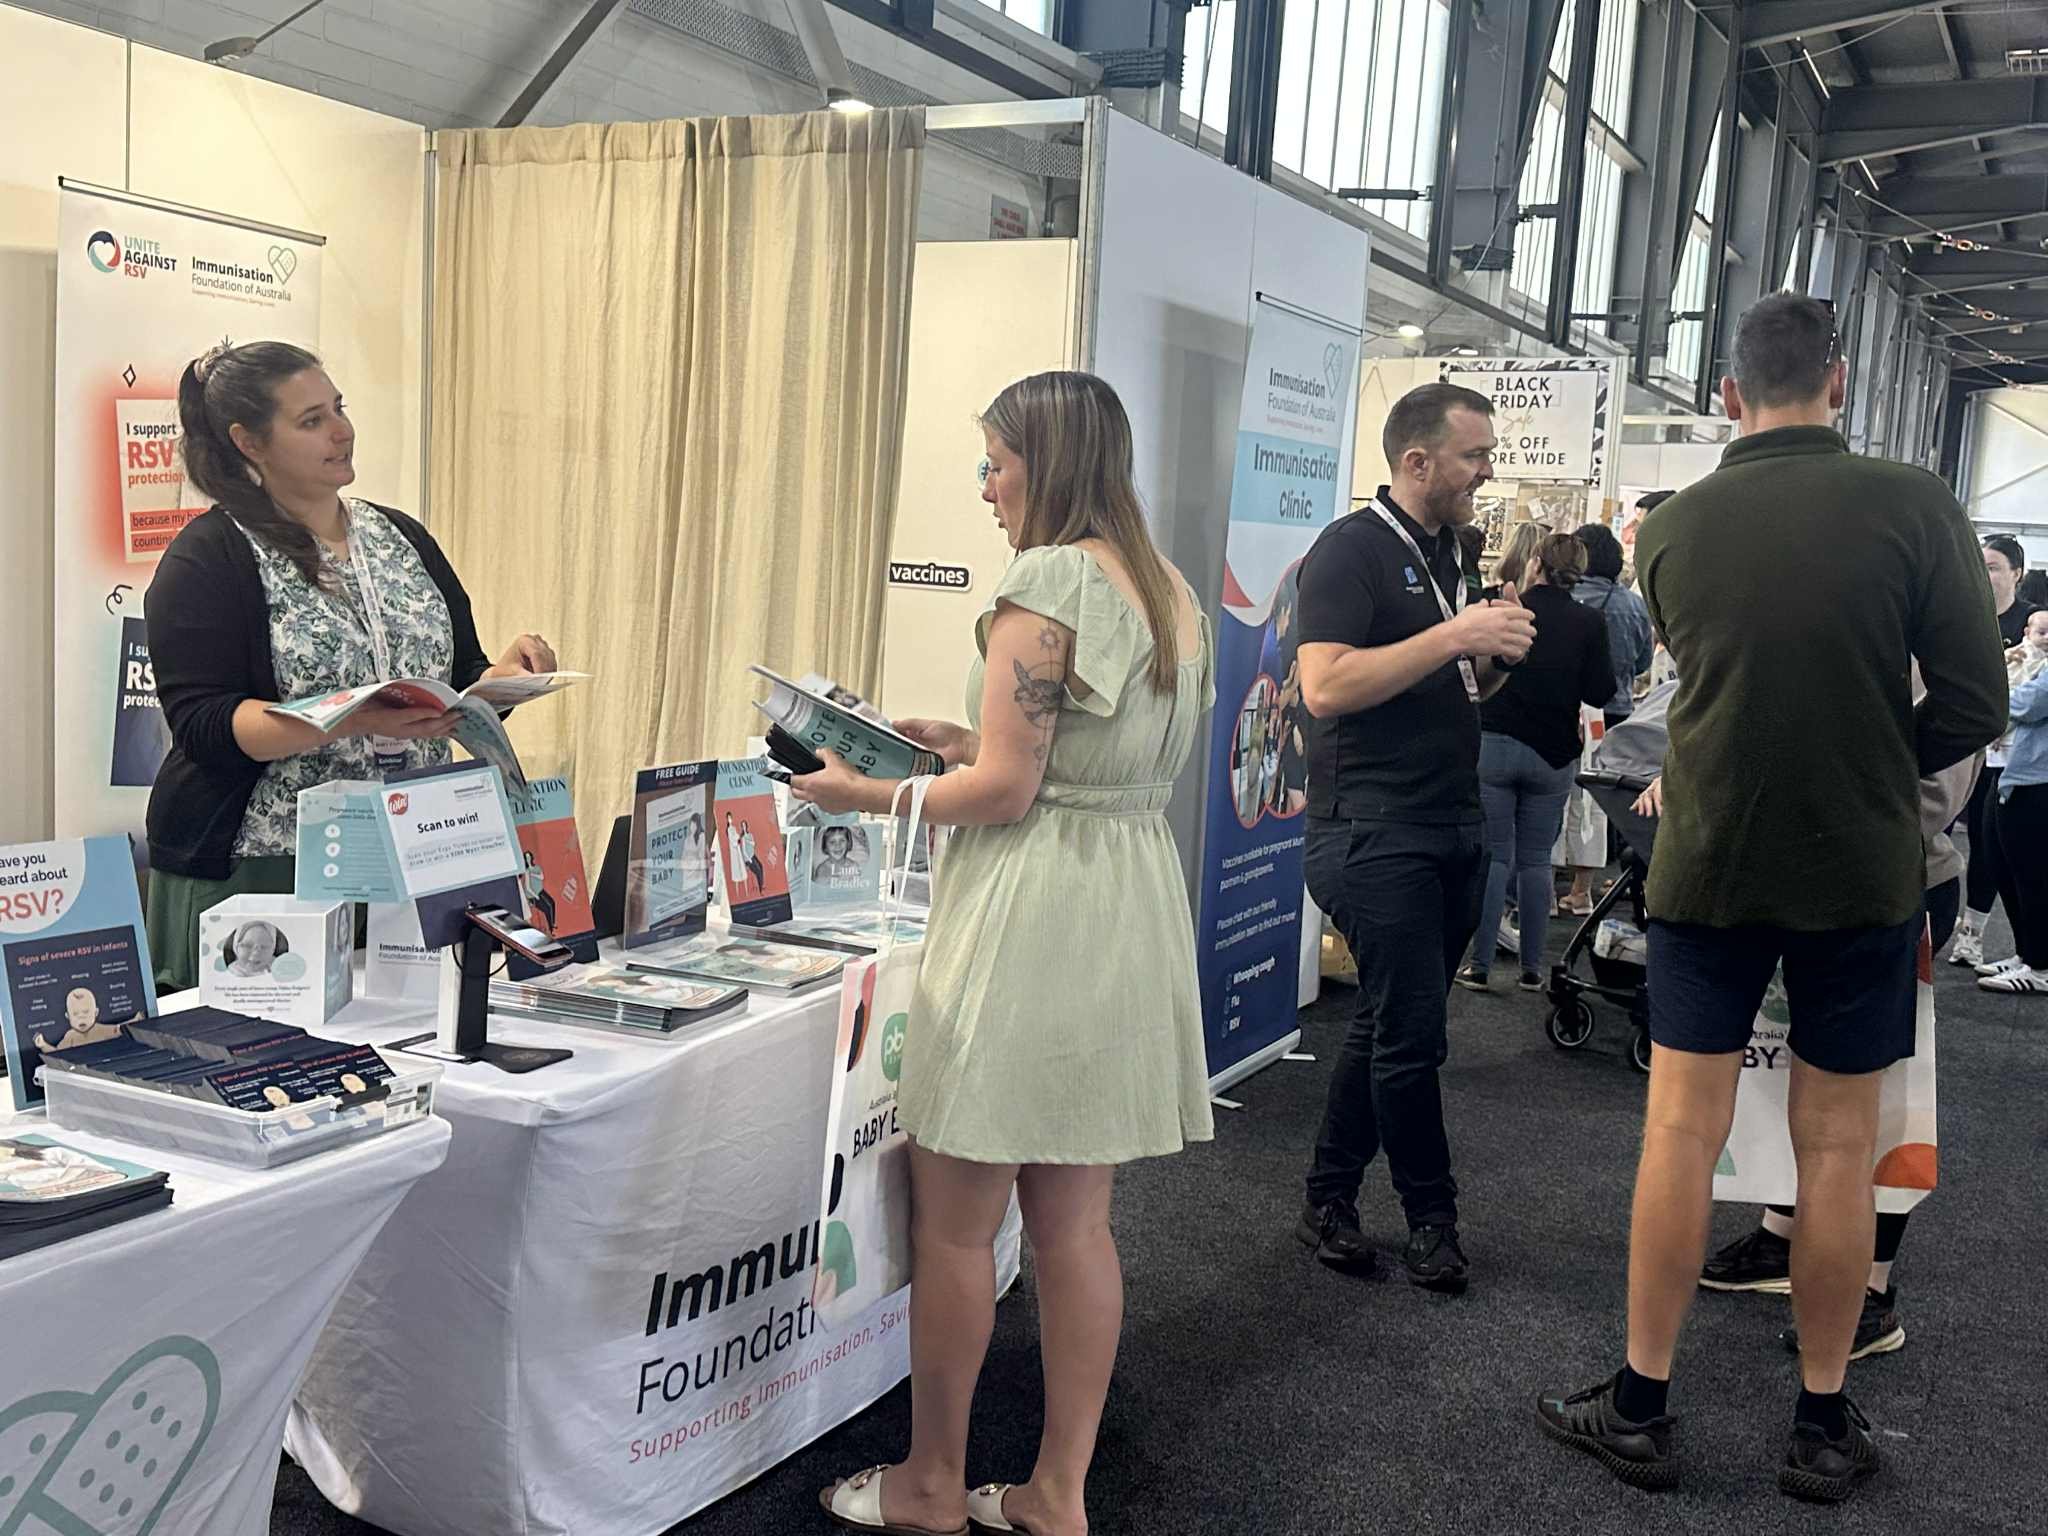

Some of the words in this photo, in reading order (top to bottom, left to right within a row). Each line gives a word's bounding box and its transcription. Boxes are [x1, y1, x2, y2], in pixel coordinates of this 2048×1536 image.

[124, 236, 160, 254] UNITE
[124, 250, 177, 271] AGAINST
[192, 256, 273, 284] Immunisation
[124, 264, 148, 279] RSV
[191, 273, 242, 293] Foundation
[245, 284, 254, 294] of
[255, 286, 291, 302] Australia
[1269, 367, 1325, 399] Immunisation
[1495, 377, 1551, 391] BLACK
[1267, 392, 1301, 413] Foundation
[1310, 402, 1336, 422] Australia
[1491, 394, 1553, 408] FRIDAY
[126, 422, 130, 435] I
[133, 423, 176, 438] support
[1520, 436, 1549, 449] OFF
[127, 440, 175, 469] RSV
[1254, 443, 1337, 481] Immunisation
[1524, 452, 1566, 465] WIDE
[128, 471, 186, 488] protection
[1280, 489, 1312, 520] Clinic
[132, 514, 170, 527] because
[172, 513, 185, 525] my
[891, 564, 965, 584] vaccines
[129, 642, 134, 656] I
[656, 768, 674, 780] FREE
[675, 764, 700, 777] GUIDE
[417, 820, 442, 834] Scan
[445, 818, 456, 829] to
[458, 811, 479, 825] win!
[651, 826, 688, 849] PROTECT
[22, 853, 46, 869] you
[651, 849, 674, 865] YOUR
[31, 867, 68, 882] about
[651, 868, 674, 885] BABY
[0, 888, 64, 921] RSV?
[18, 954, 39, 967] Signs
[40, 951, 50, 961] of
[50, 949, 76, 960] severe
[77, 947, 92, 956] RSV
[93, 945, 100, 953] in
[100, 941, 128, 952] infants
[853, 1110, 888, 1159] BABY
[628, 1391, 752, 1464] Supporting
[758, 1326, 874, 1405] Immunisation,
